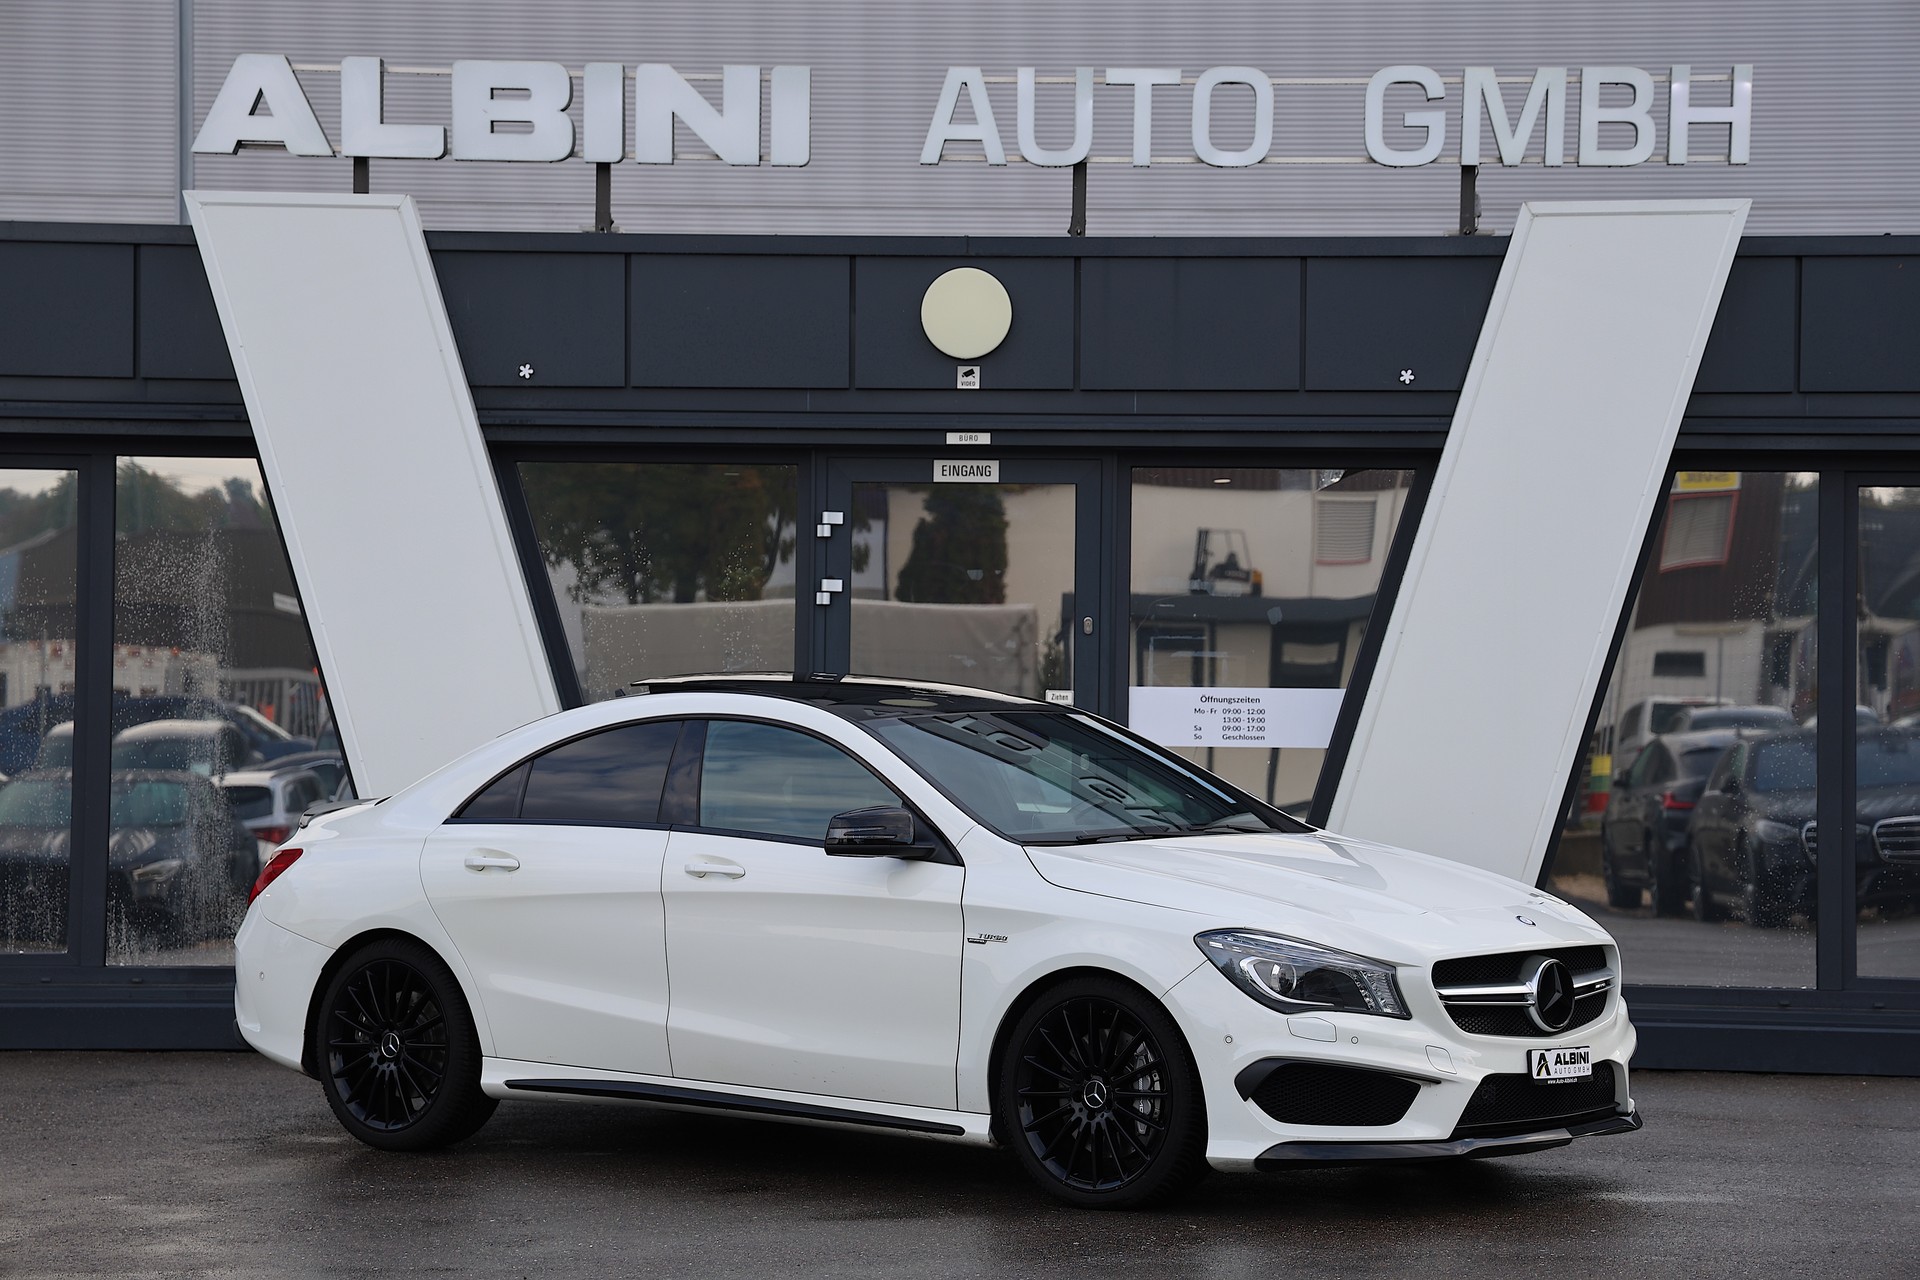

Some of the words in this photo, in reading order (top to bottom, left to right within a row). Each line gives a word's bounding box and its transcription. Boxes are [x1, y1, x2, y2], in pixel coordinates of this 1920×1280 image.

[191, 53, 811, 168] ALBINI
[920, 65, 1275, 168] AUTO
[1364, 64, 1754, 168] GMBH
[959, 434, 979, 442] BÜRO
[941, 465, 992, 477] EINGANG
[1200, 695, 1260, 704] Öffnungszeiten
[1554, 1052, 1589, 1066] ALBINI
[1554, 1067, 1571, 1075] AUTO
